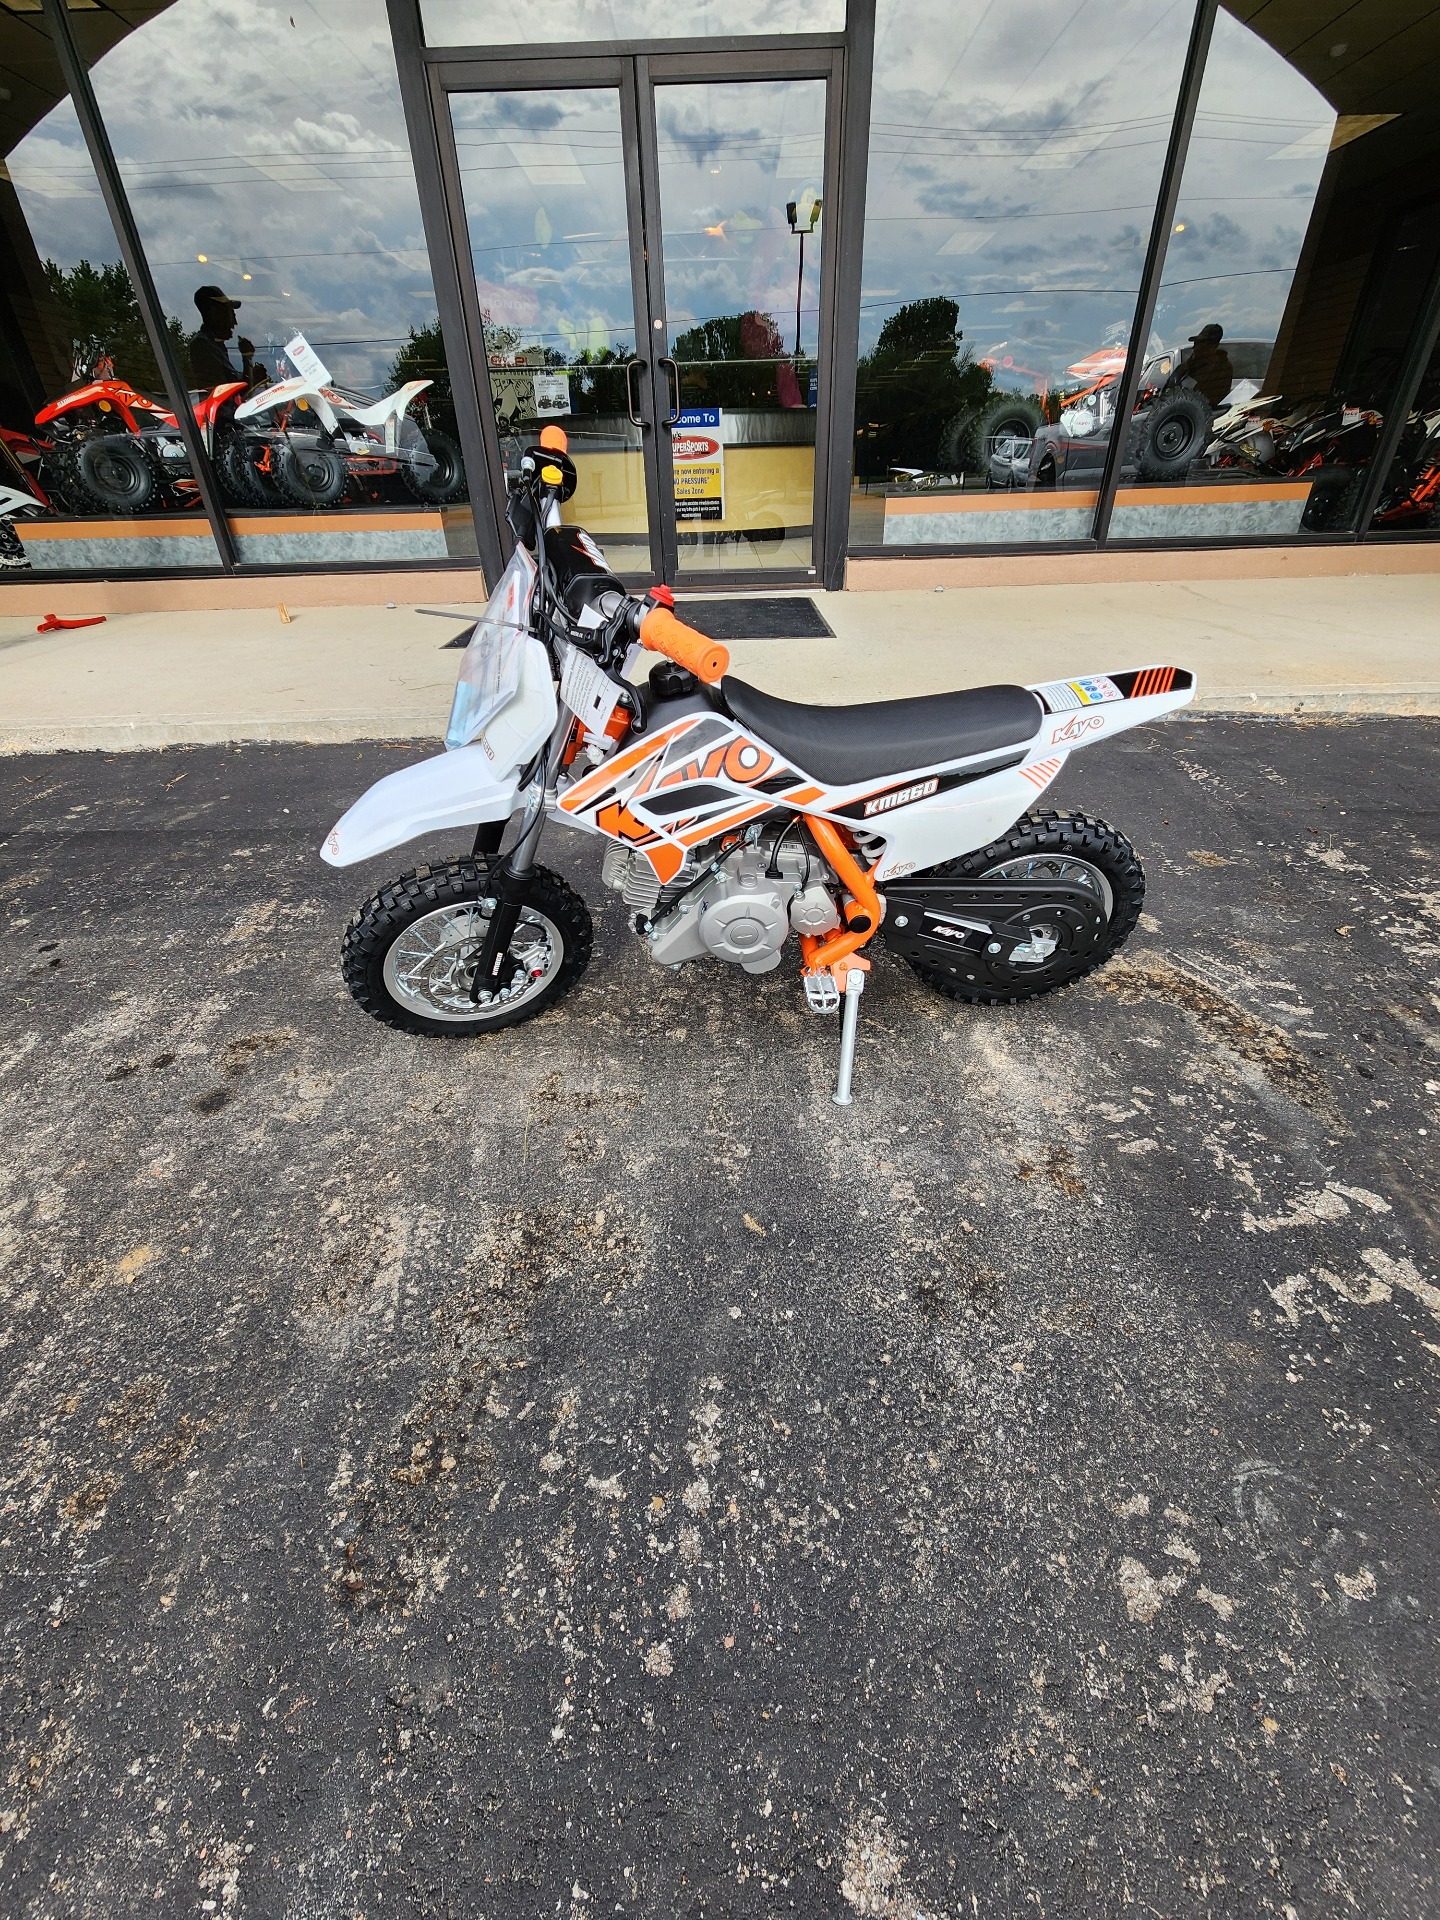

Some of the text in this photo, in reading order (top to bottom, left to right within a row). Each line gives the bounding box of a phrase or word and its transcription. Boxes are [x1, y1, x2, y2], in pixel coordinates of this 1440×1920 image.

[703, 413, 715, 423] To
[693, 467, 715, 476] entering
[692, 487, 705, 495] Zone
